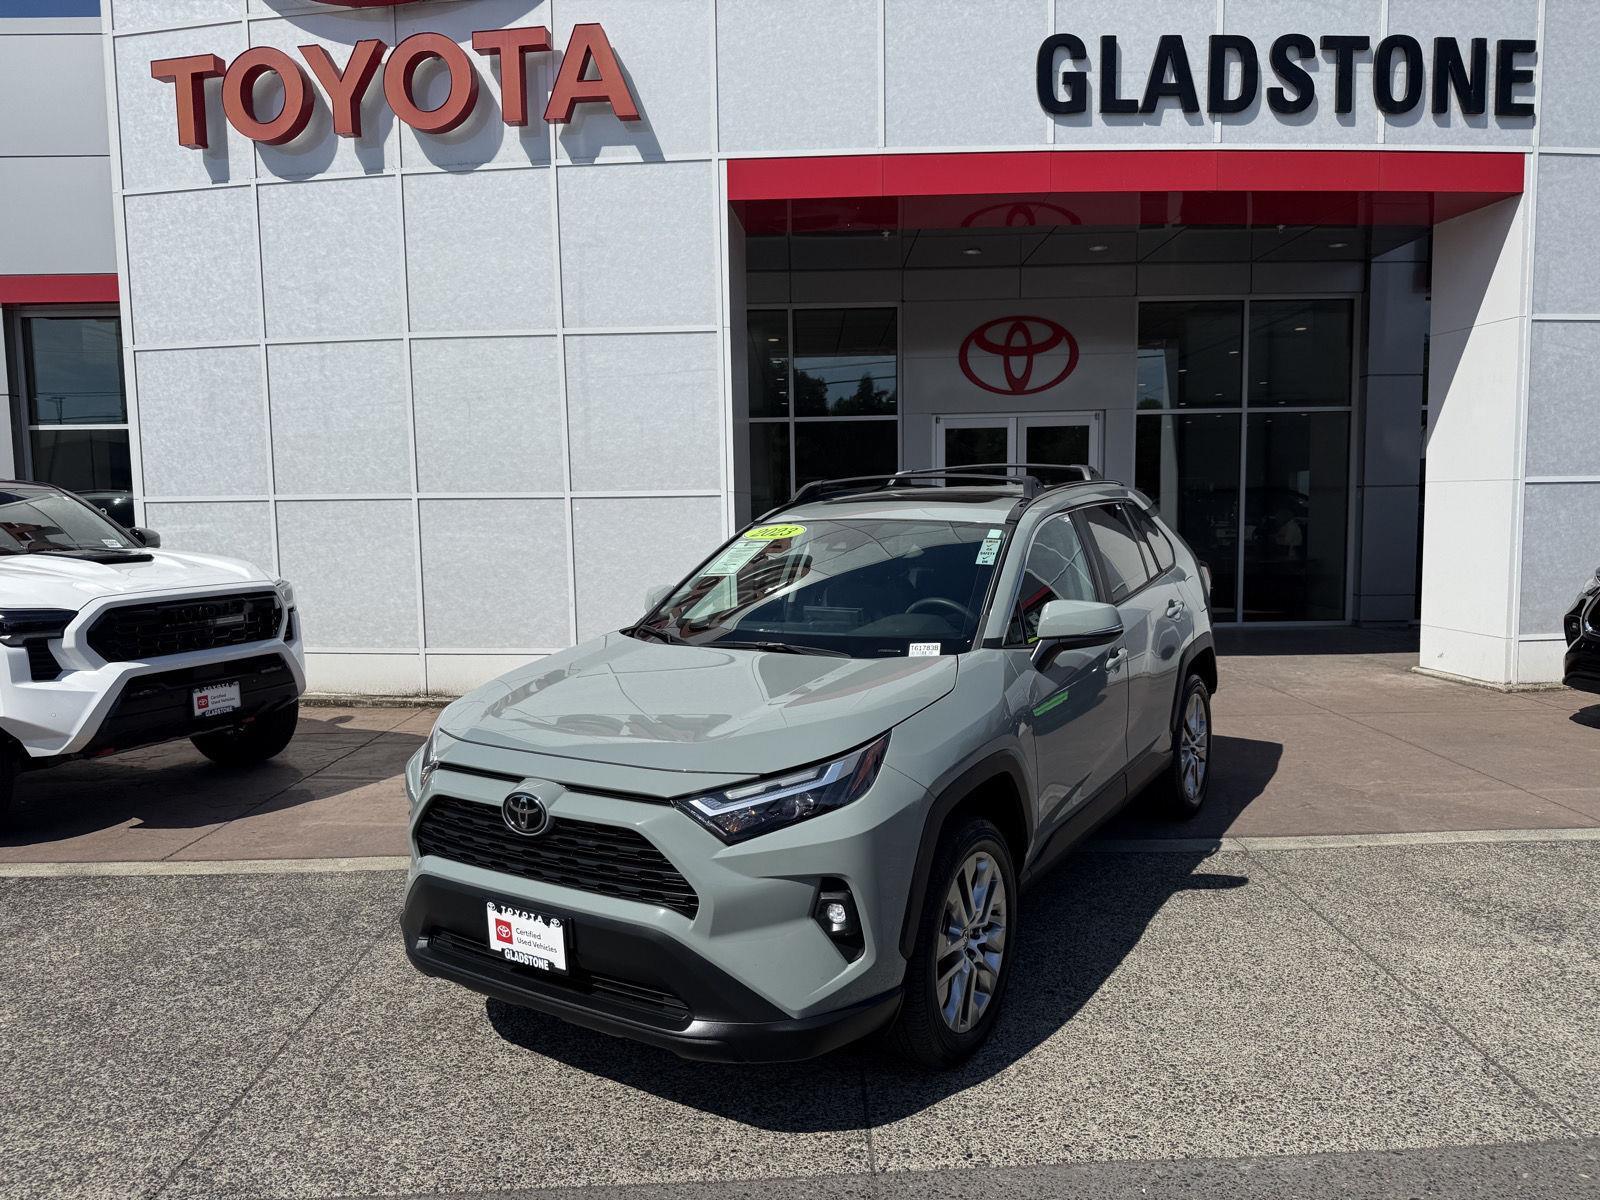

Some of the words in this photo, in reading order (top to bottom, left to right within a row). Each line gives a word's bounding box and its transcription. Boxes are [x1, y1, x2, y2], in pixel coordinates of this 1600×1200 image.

[1036, 33, 1537, 116] GLADSTONE
[151, 23, 641, 149] TOYOTA
[750, 527, 799, 538] 2023
[205, 706, 233, 717] GLADSTONE
[500, 906, 543, 923] TOYOTA
[516, 928, 541, 940] Certified
[516, 937, 532, 947] Used
[532, 941, 558, 953] Vehicles
[505, 949, 550, 970] GLADSTONE
